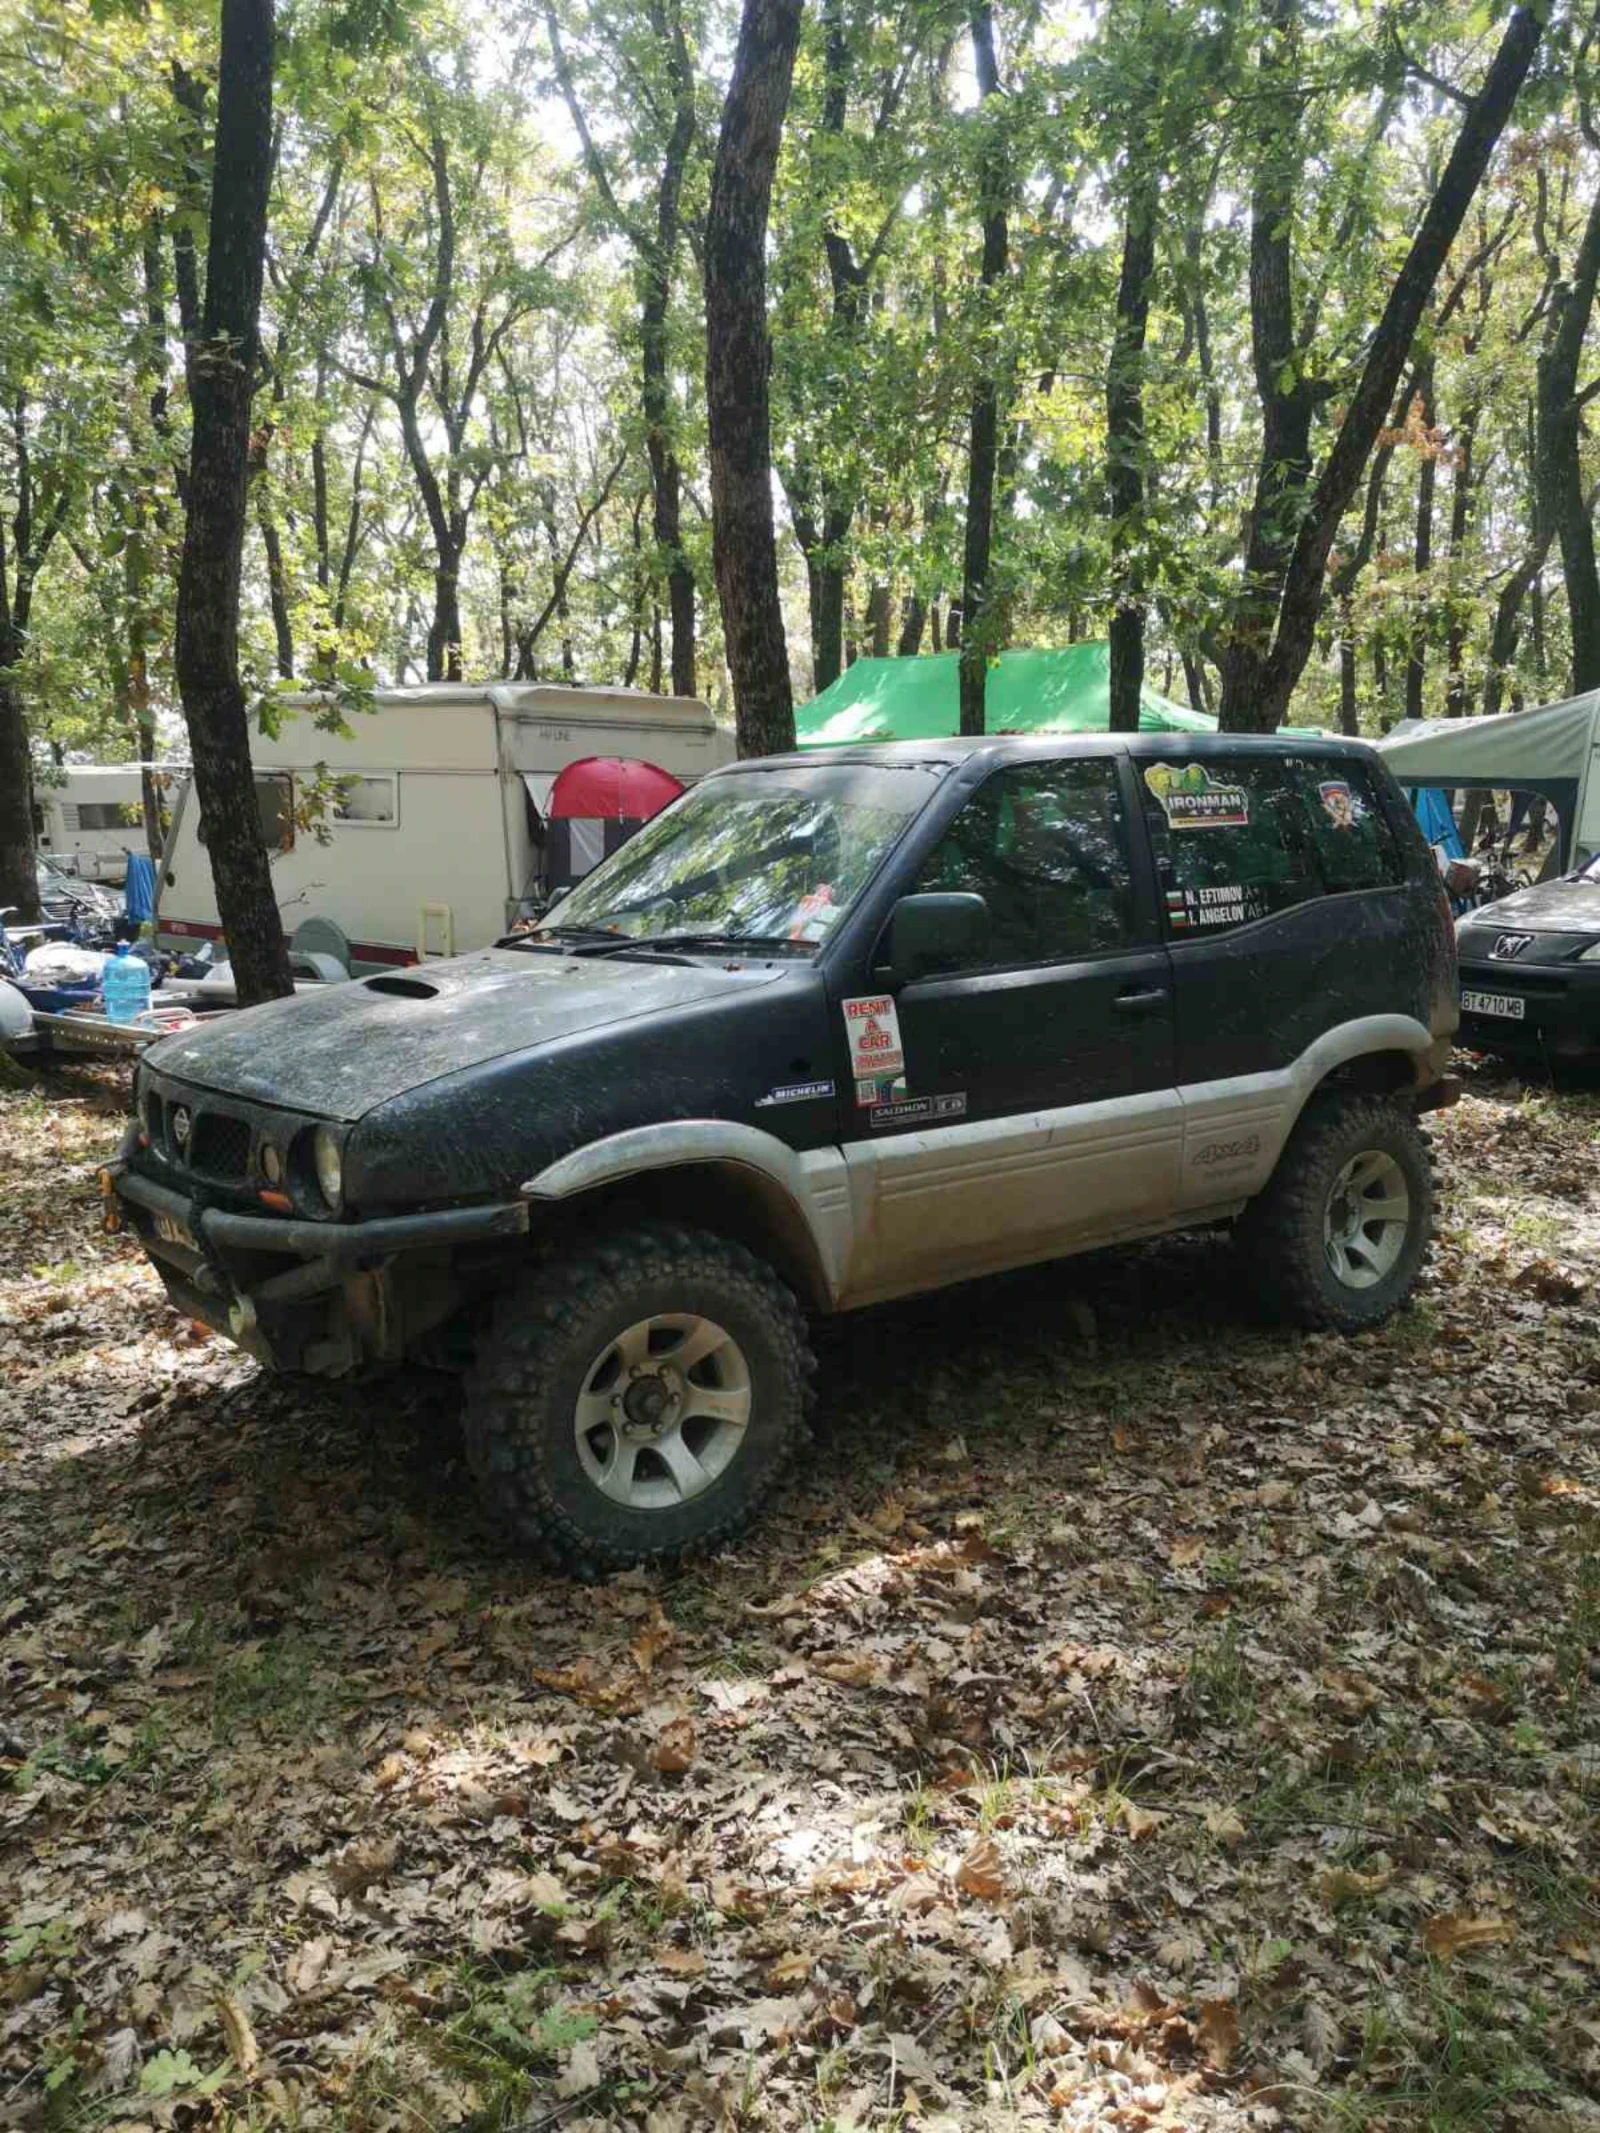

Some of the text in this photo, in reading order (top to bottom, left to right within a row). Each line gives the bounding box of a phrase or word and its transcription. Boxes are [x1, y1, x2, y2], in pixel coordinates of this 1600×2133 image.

[1168, 794, 1241, 809] IRONMAN
[1199, 885, 1242, 904] EFTIMOV
[1199, 905, 1244, 925] ANGELOV
[848, 1001, 891, 1017] RENT
[1478, 996, 1505, 1014] 4710
[1507, 999, 1522, 1016] MB
[859, 1031, 892, 1049] CAR
[775, 1084, 830, 1098] MICHELIN
[875, 1101, 928, 1117] SALOMON
